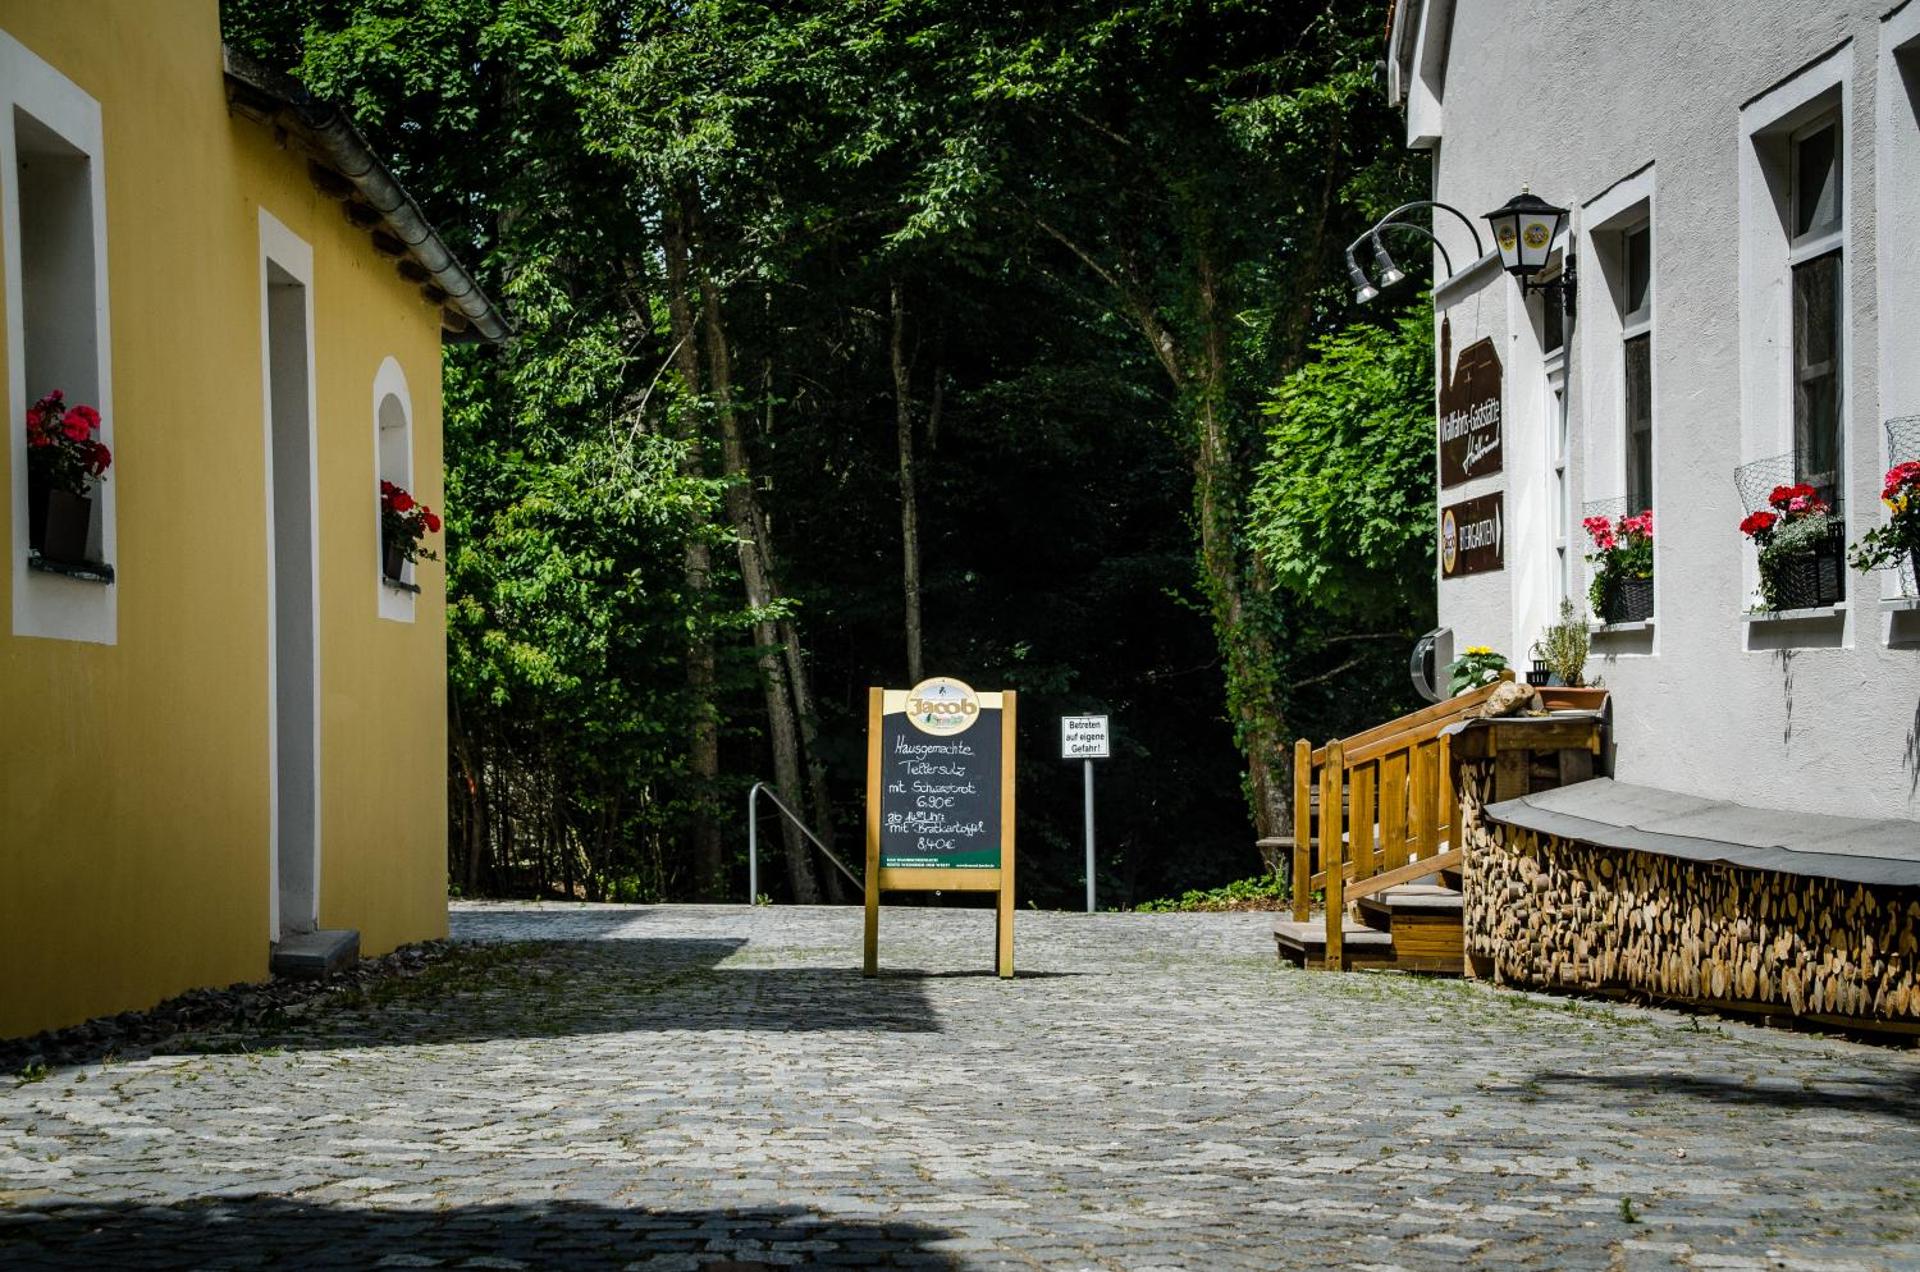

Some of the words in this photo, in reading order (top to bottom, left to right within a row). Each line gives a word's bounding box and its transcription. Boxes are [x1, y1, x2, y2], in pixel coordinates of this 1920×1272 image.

[909, 698, 977, 716] Jacob
[1069, 721, 1101, 729] Betreten
[1066, 733, 1078, 742] auf
[1080, 733, 1105, 742] eigene
[1071, 744, 1101, 753] Gefahr!
[890, 822, 909, 833] mit
